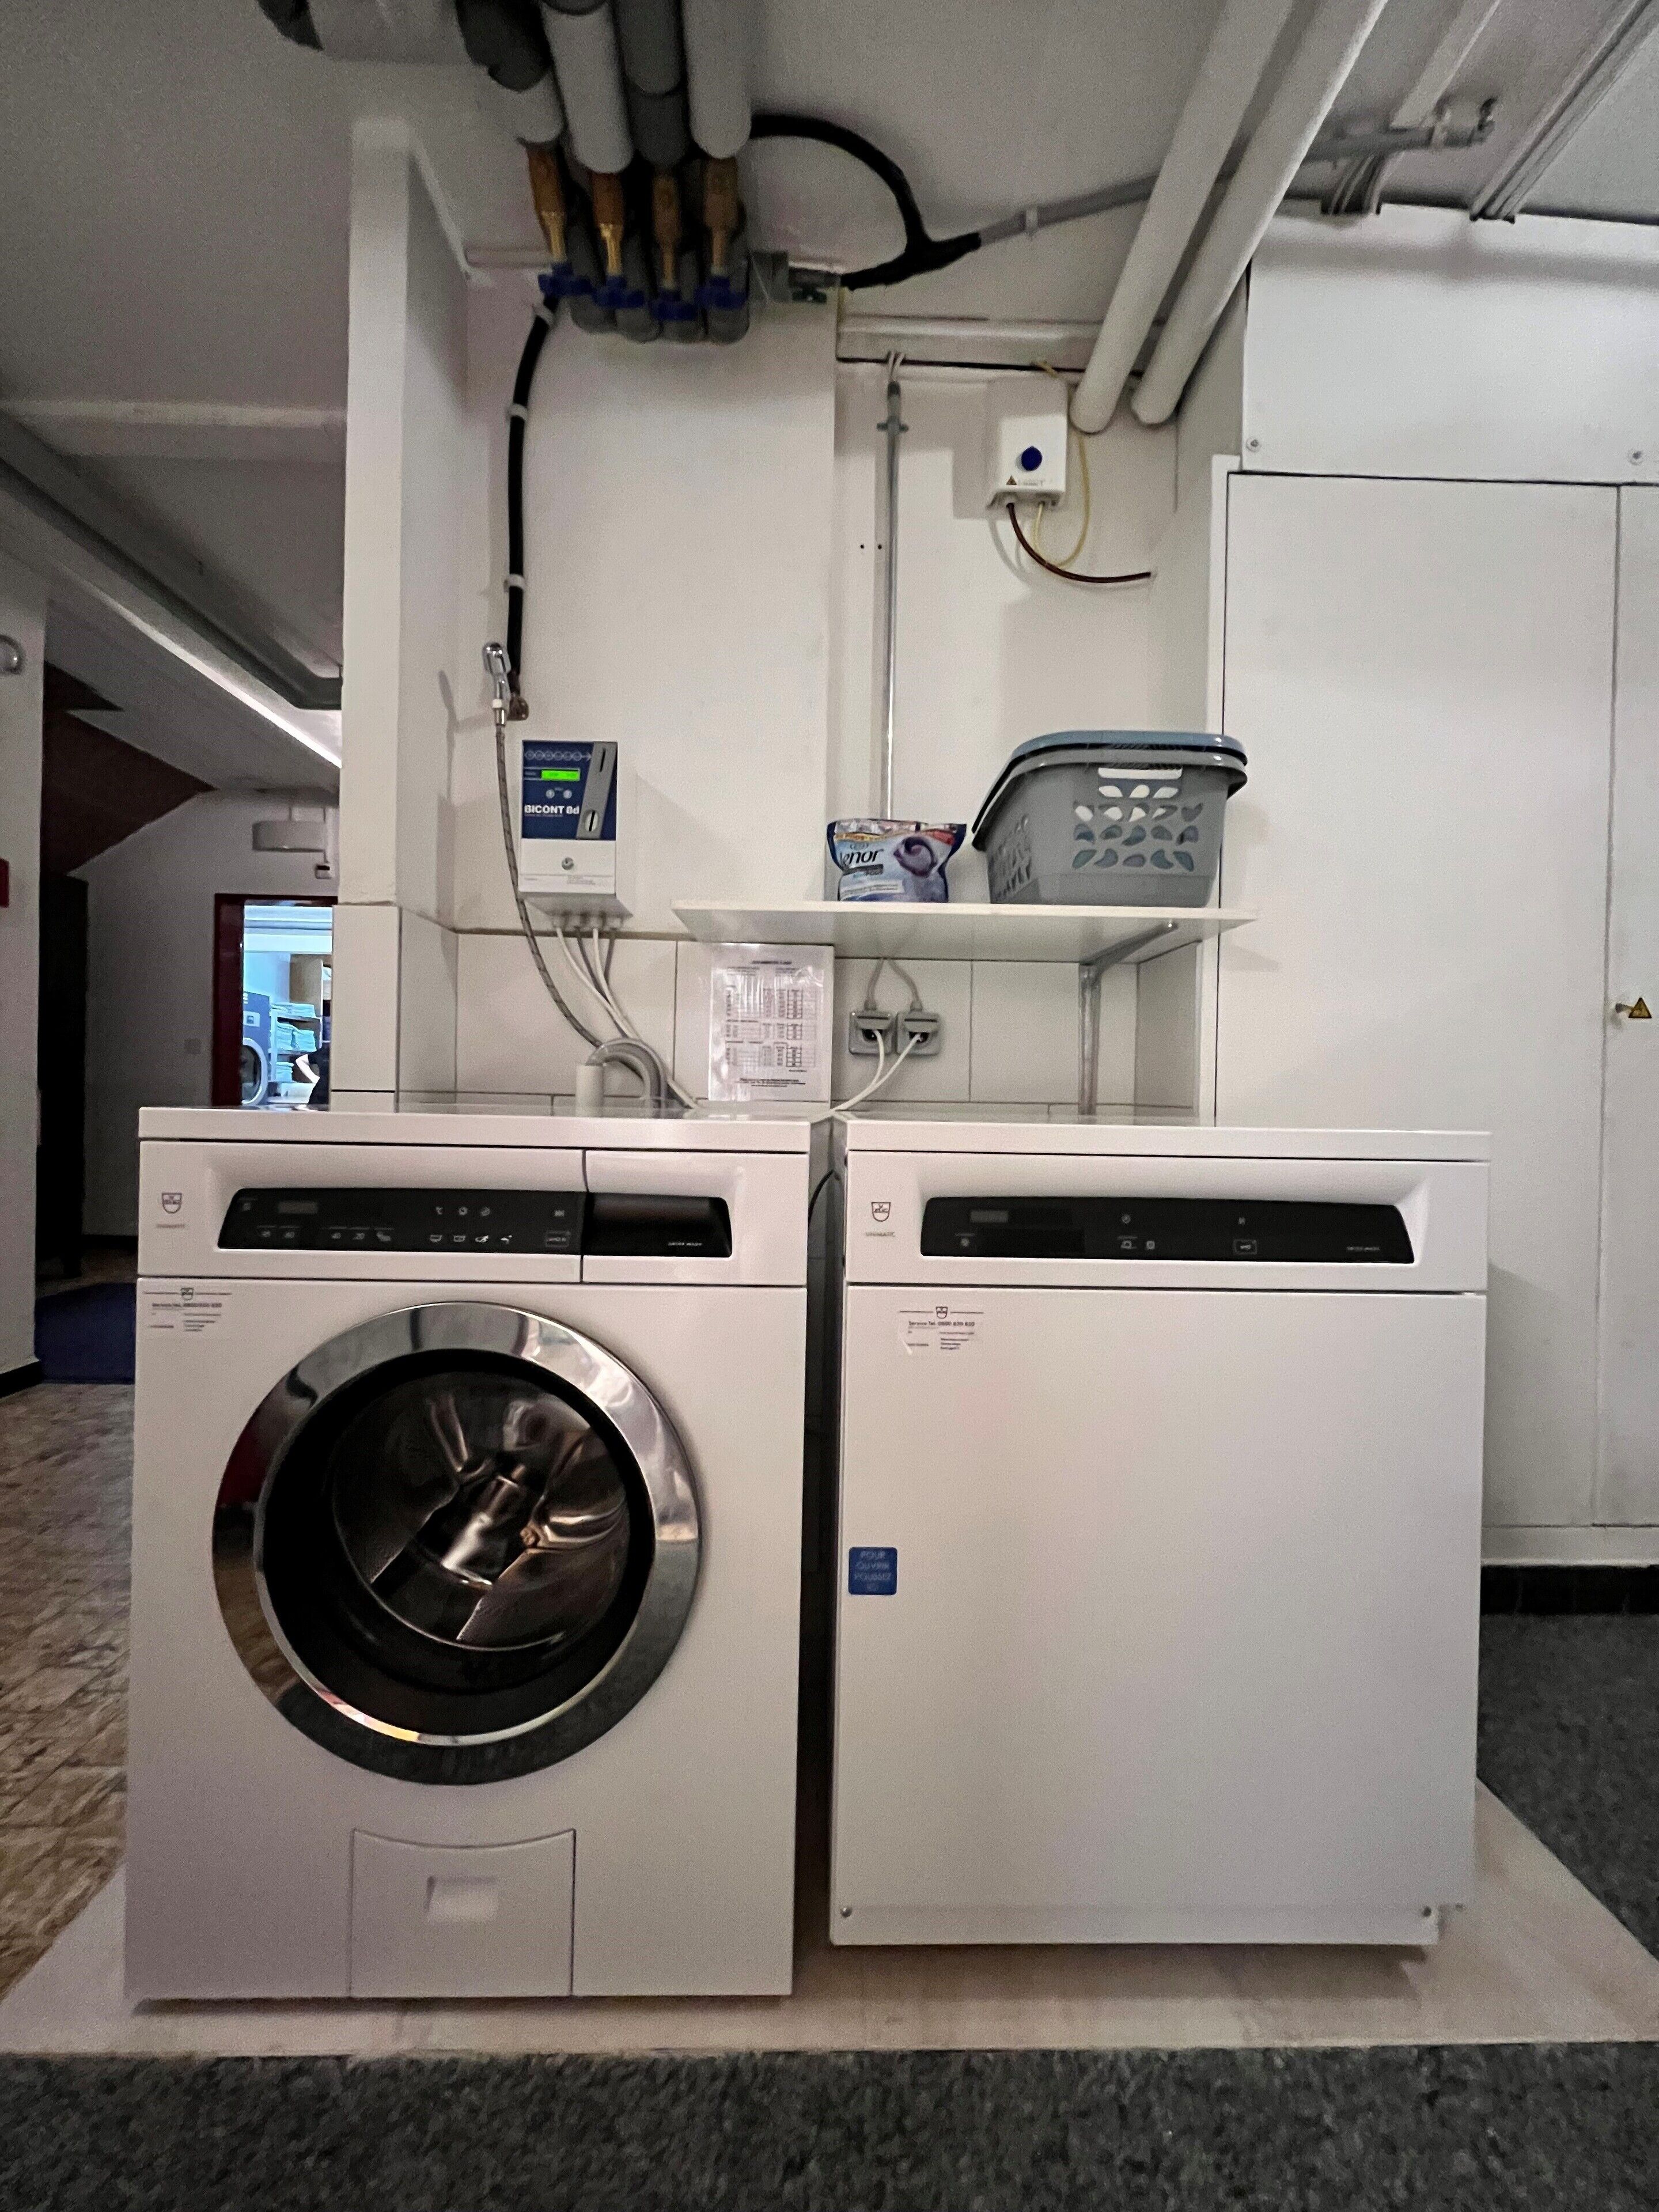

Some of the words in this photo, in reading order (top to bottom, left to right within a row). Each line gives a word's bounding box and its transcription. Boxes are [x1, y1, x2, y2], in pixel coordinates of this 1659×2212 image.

[524, 805, 565, 813] BICONT
[860, 1551, 886, 1559] POUR
[854, 1572, 892, 1581] POUSSEZ
